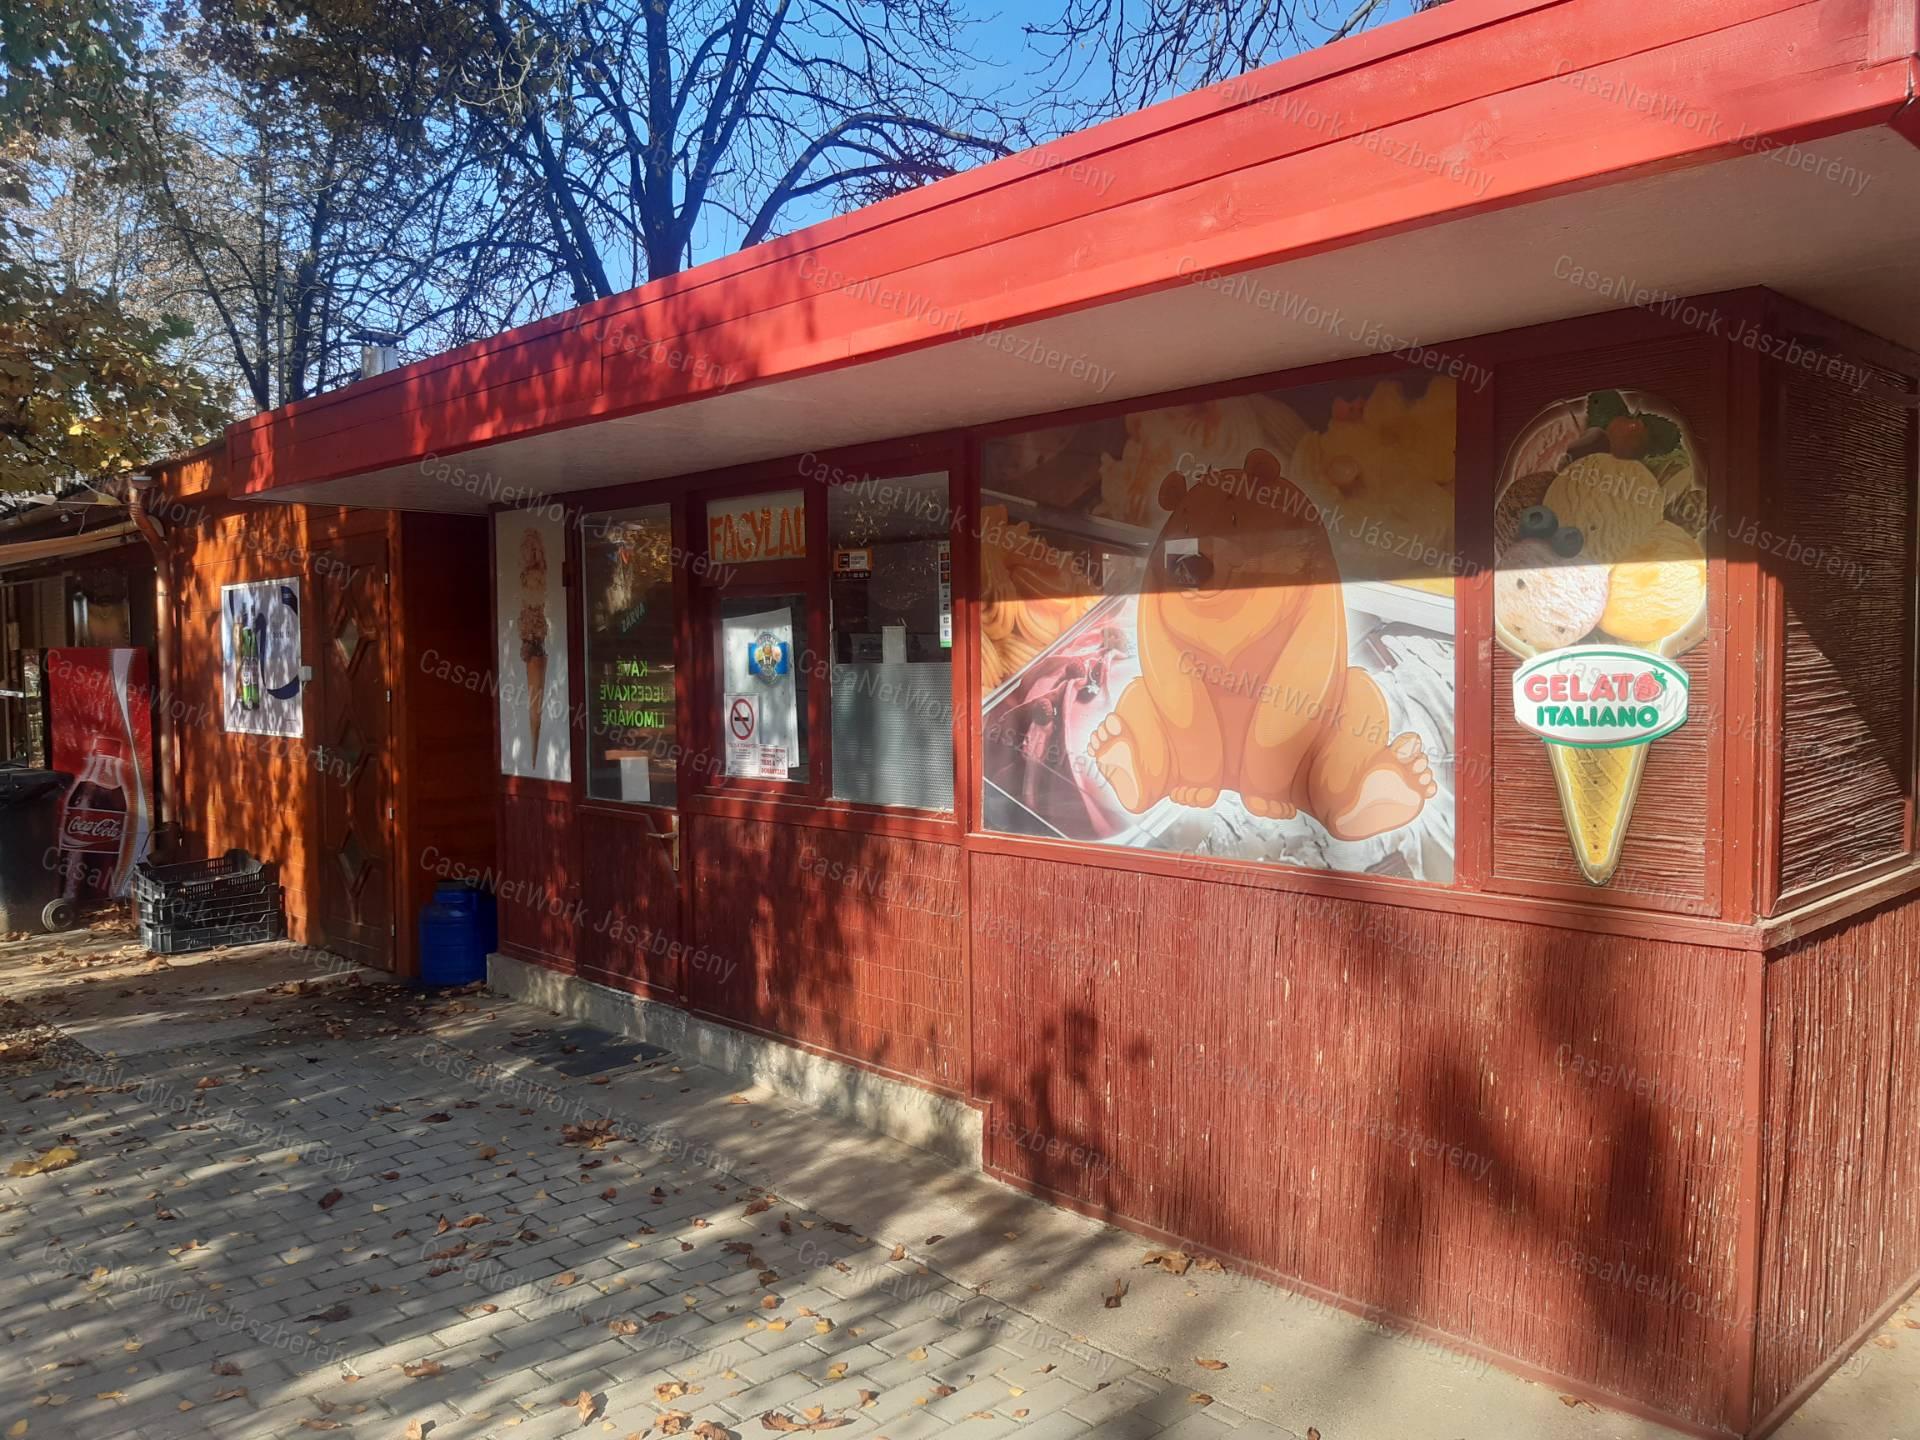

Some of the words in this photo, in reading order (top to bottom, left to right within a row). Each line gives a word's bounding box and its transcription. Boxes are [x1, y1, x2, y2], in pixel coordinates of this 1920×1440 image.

[709, 506, 807, 561] FAGYLAL
[1524, 669, 1665, 704] GELATO
[1536, 704, 1660, 729] ITALIANO
